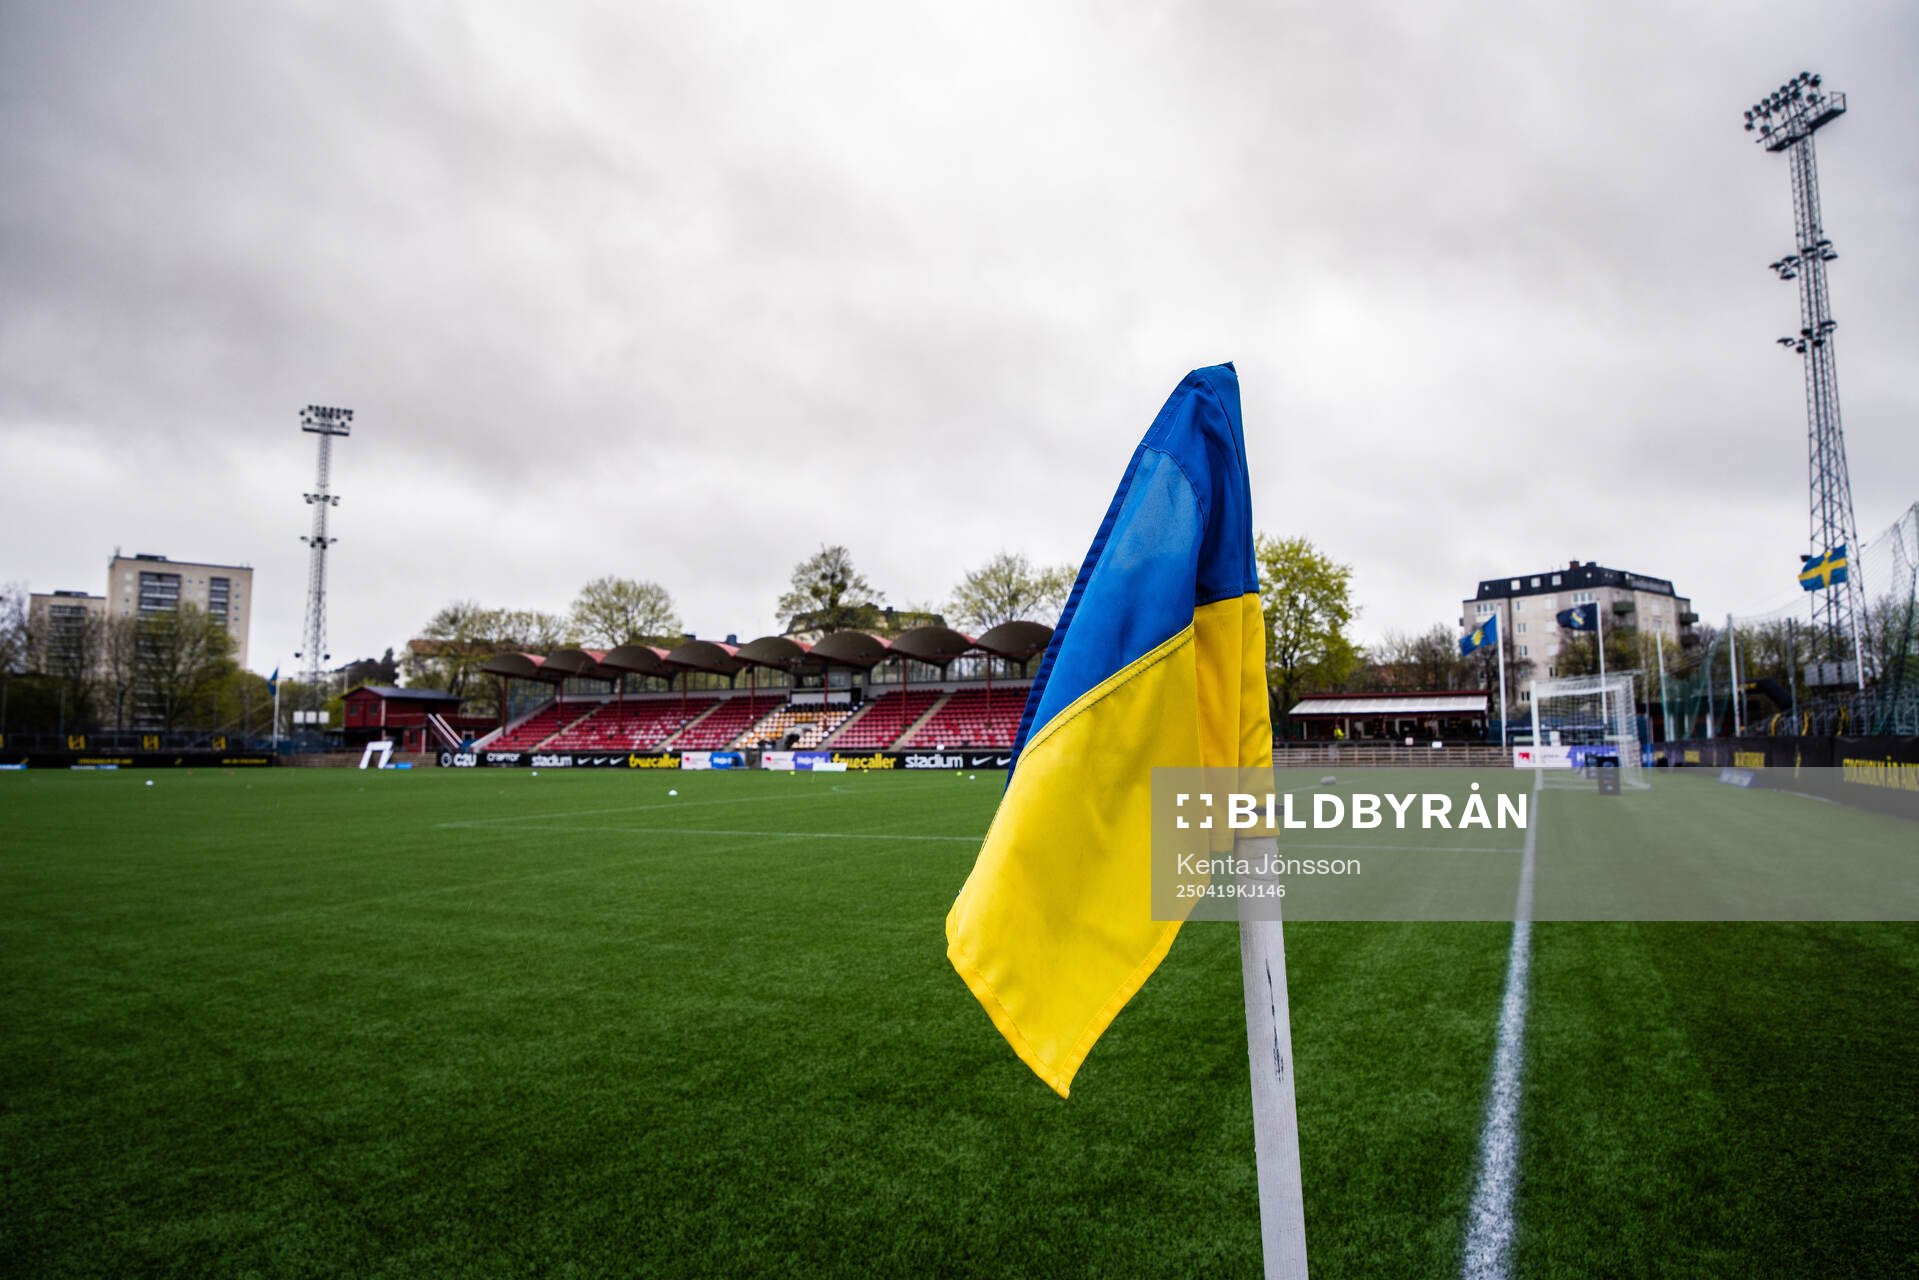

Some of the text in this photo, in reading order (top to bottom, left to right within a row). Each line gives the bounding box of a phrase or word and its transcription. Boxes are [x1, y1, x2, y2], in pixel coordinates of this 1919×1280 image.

[531, 754, 573, 767] stadium
[628, 753, 681, 769] truecaller
[905, 754, 964, 768] stadium
